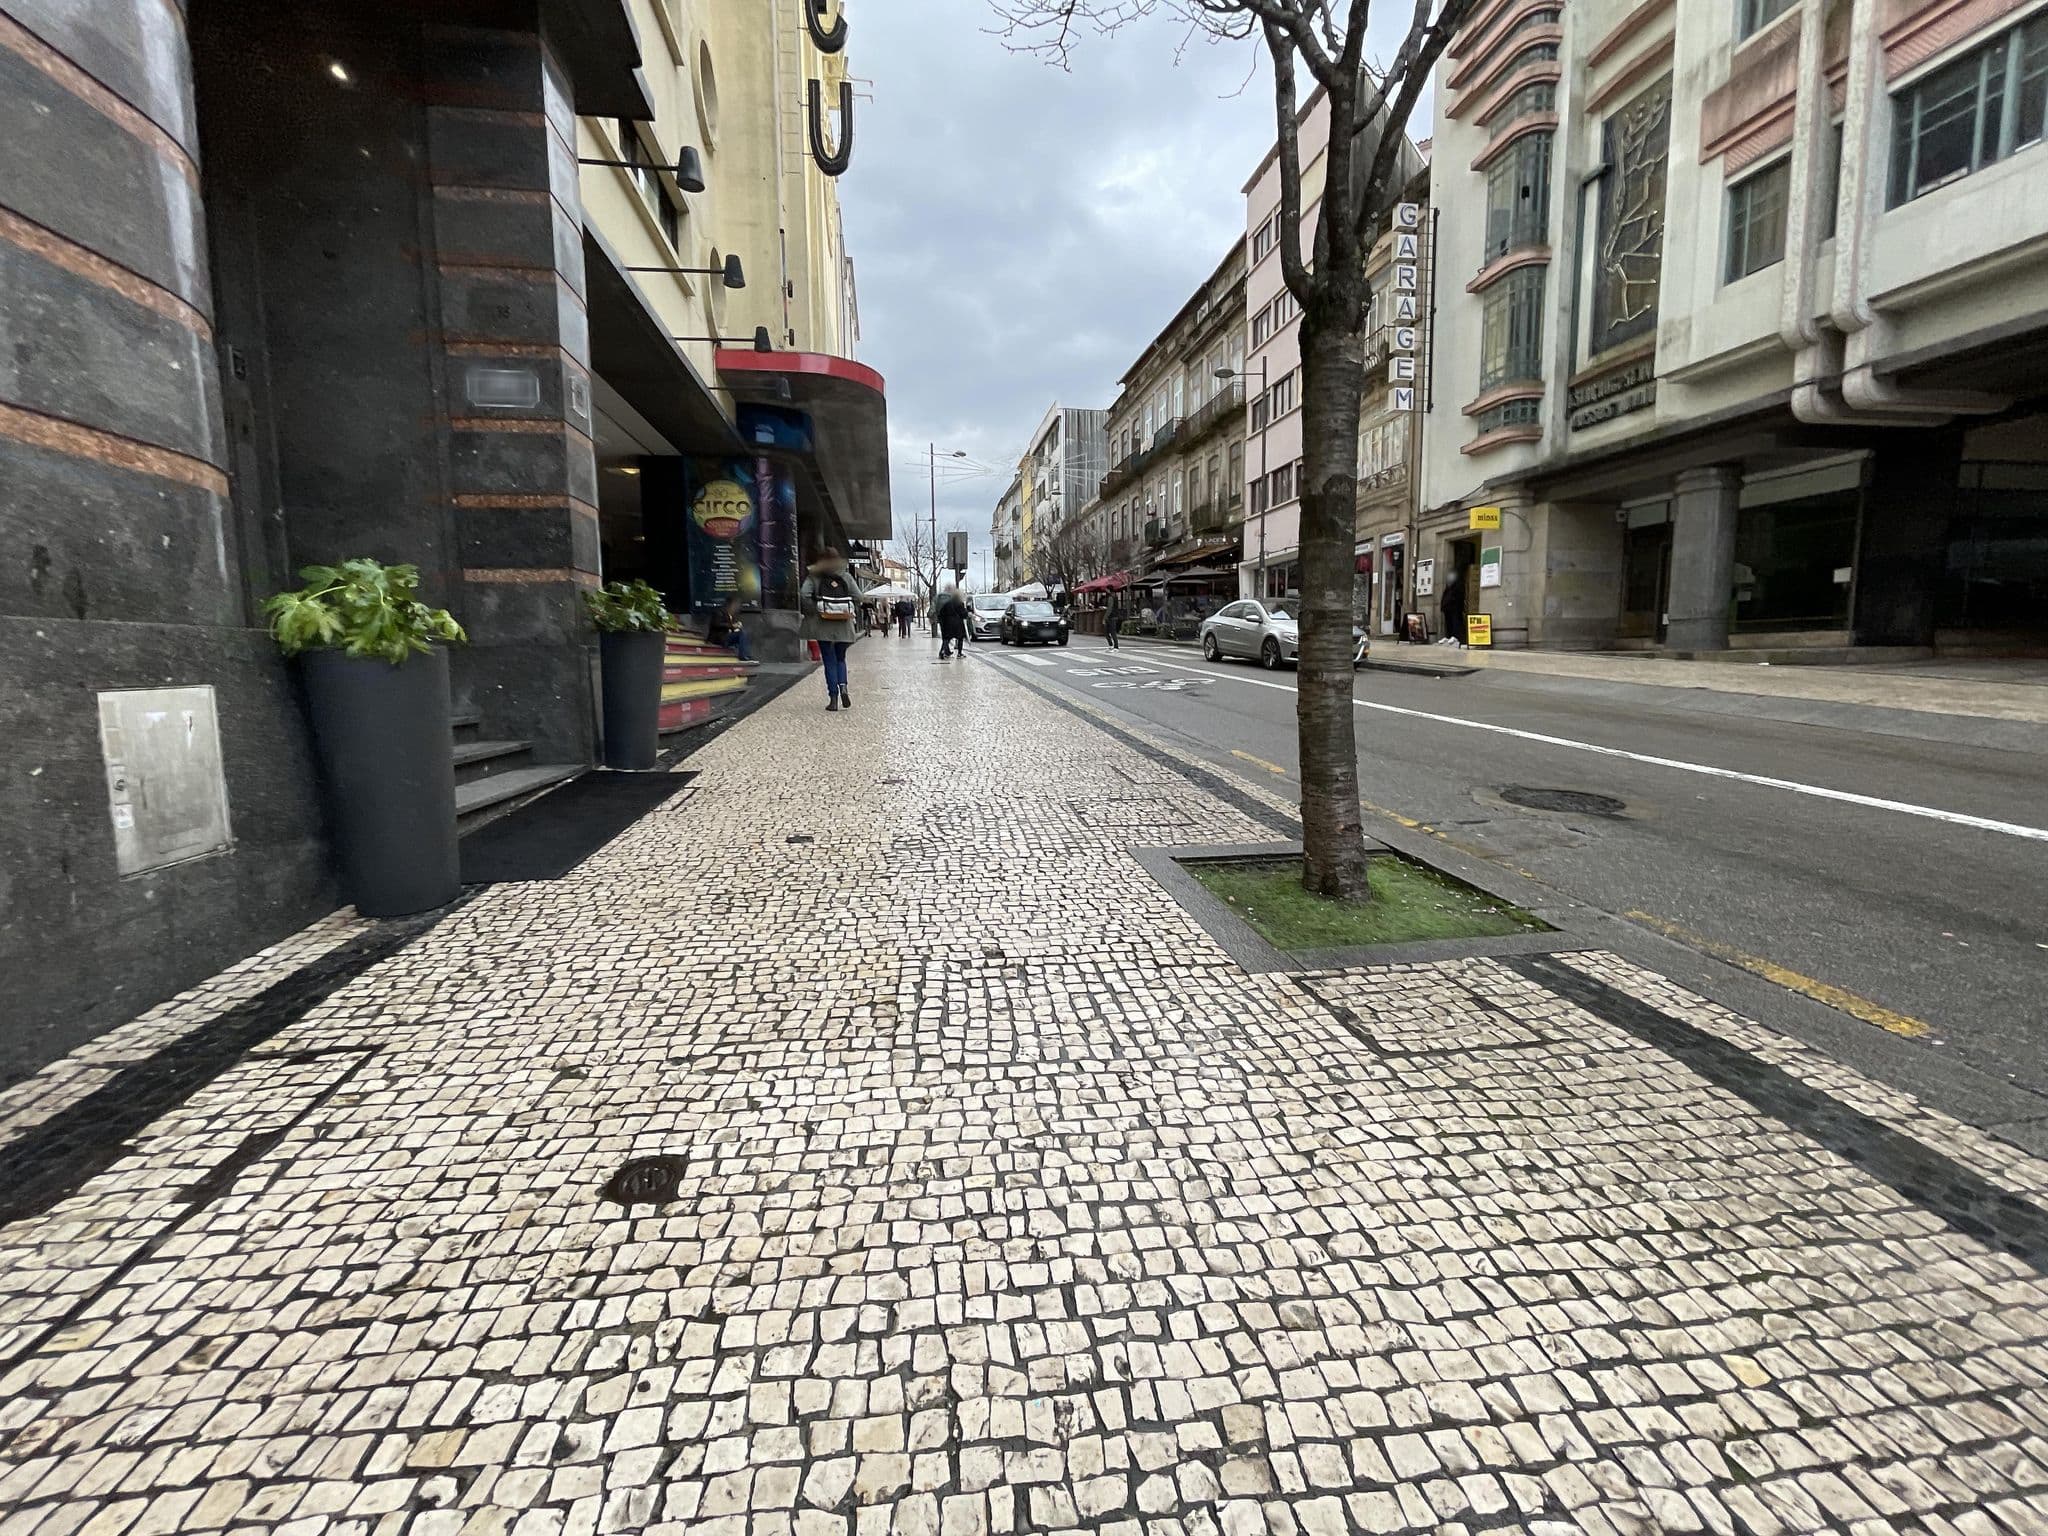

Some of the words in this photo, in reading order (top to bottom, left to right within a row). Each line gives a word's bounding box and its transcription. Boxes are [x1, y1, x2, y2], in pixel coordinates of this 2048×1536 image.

[1395, 205, 1416, 409] GARAGEM
[692, 500, 750, 514] circo
[1066, 666, 1160, 677] BUS
